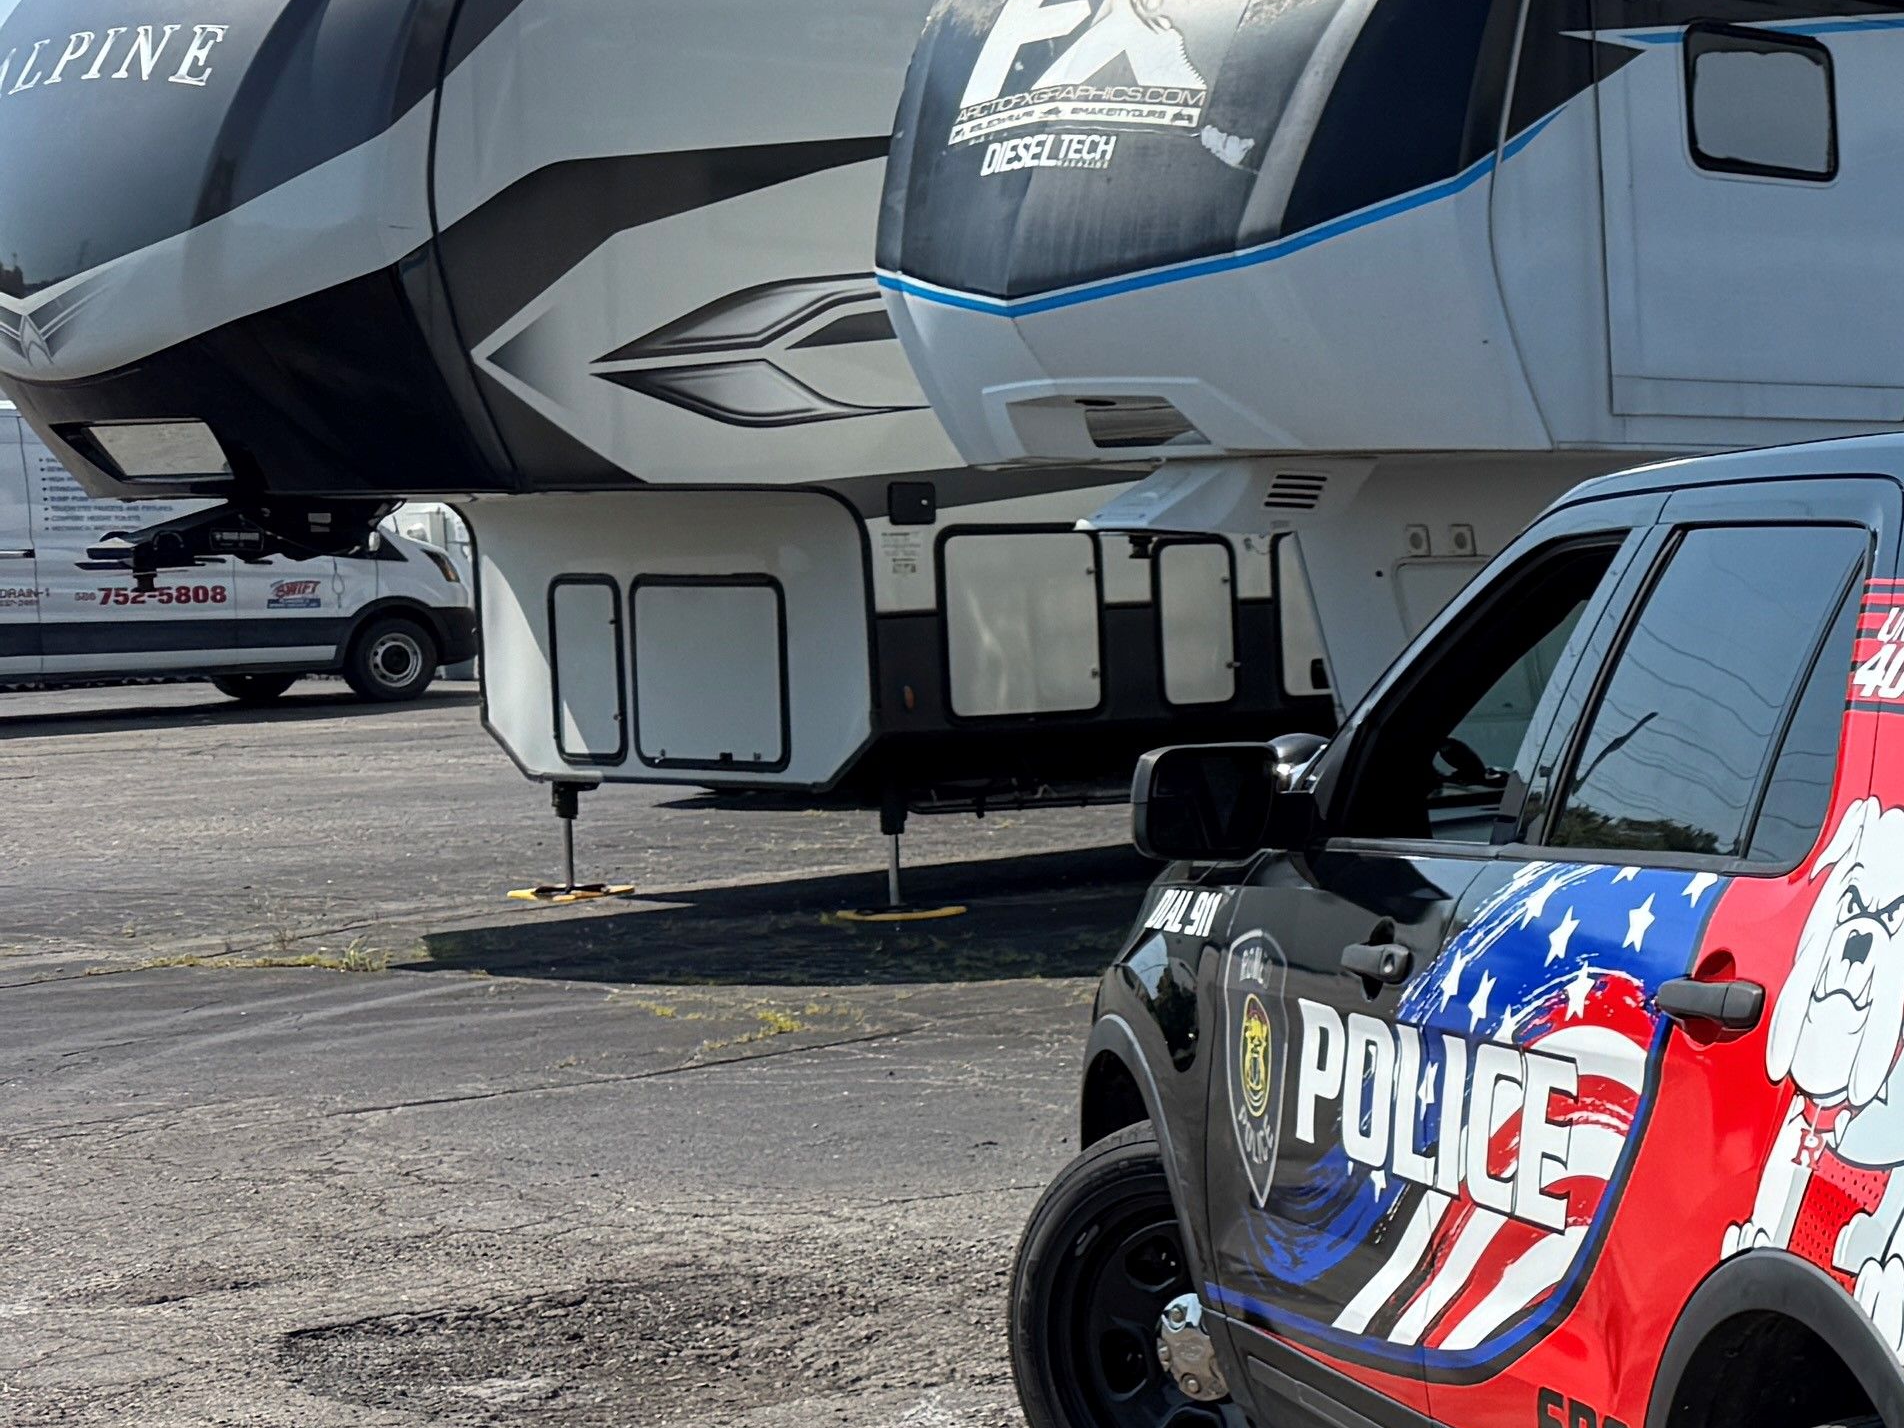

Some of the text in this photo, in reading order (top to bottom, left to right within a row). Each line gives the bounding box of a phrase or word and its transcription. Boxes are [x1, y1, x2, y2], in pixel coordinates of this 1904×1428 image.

[97, 585, 227, 605] 752-5808
[1144, 889, 1223, 937] DIAL 911
[1238, 1104, 1275, 1164] POLICE
[1298, 997, 1581, 1234] POLICE
